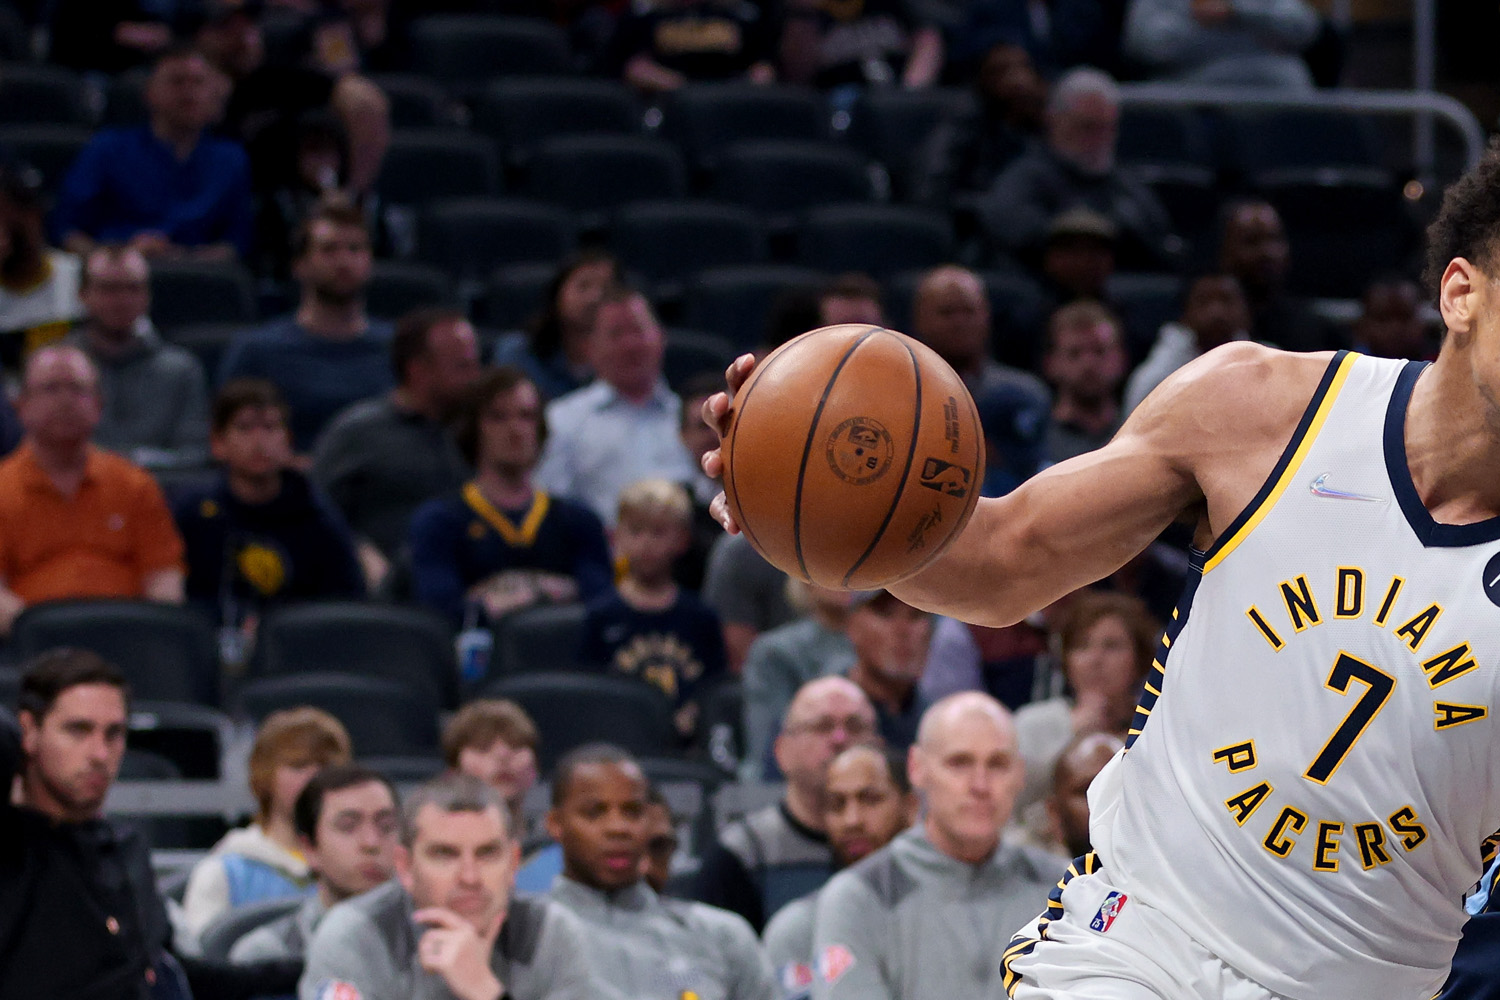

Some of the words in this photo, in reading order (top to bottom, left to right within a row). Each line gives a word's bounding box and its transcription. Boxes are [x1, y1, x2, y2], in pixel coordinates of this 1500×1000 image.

[1245, 565, 1489, 731] INDIANA
[1302, 649, 1398, 787] 7
[1212, 738, 1430, 873] PACERS
